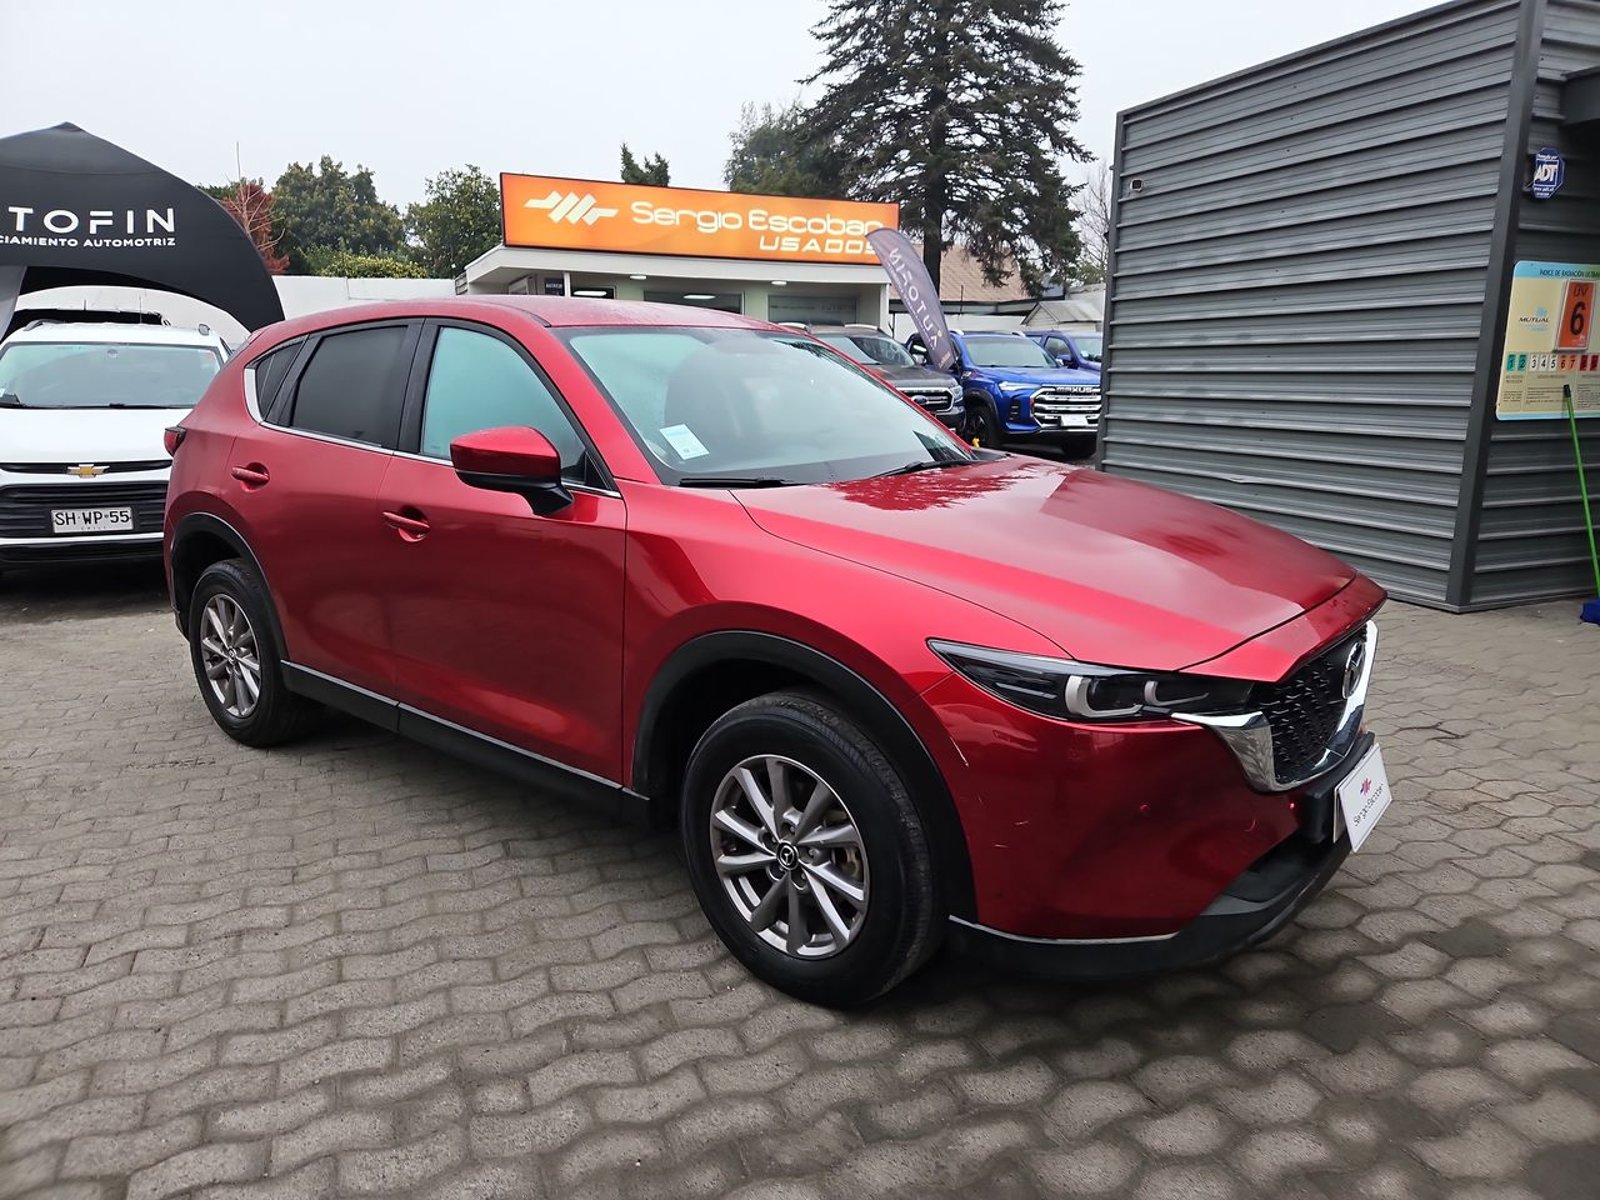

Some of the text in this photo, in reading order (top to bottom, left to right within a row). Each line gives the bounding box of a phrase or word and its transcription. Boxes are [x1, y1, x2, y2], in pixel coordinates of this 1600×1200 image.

[1534, 164, 1557, 182] ADT
[8, 205, 176, 235] TOFIN
[630, 200, 884, 236] Sergio Escobar
[83, 237, 176, 248] AUTOMOTRIZ
[1573, 286, 1589, 297] UV
[1570, 301, 1586, 336] 6
